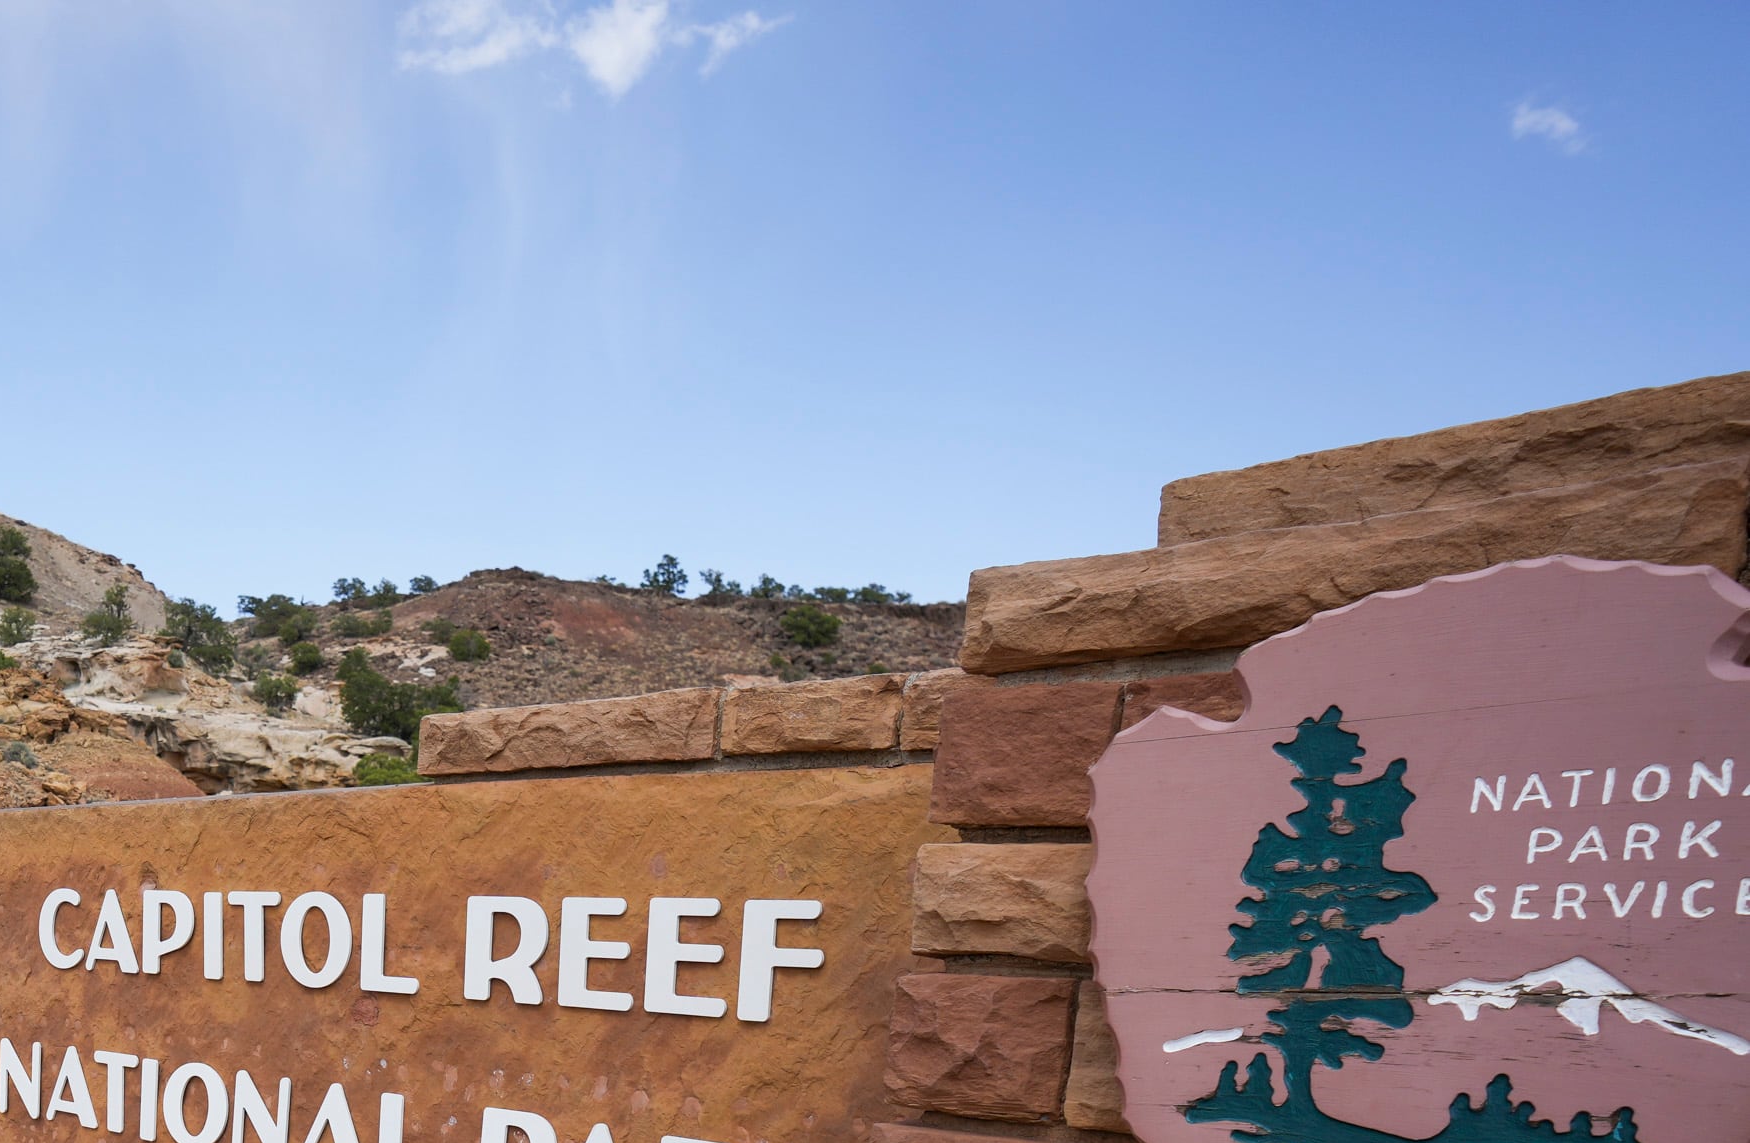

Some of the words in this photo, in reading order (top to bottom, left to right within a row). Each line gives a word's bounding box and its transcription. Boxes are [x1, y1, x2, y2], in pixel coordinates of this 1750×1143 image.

[1469, 758, 1750, 813] NATION
[1526, 819, 1722, 864] PARK
[38, 886, 420, 995] CAPITOL
[463, 894, 825, 1022] REEF
